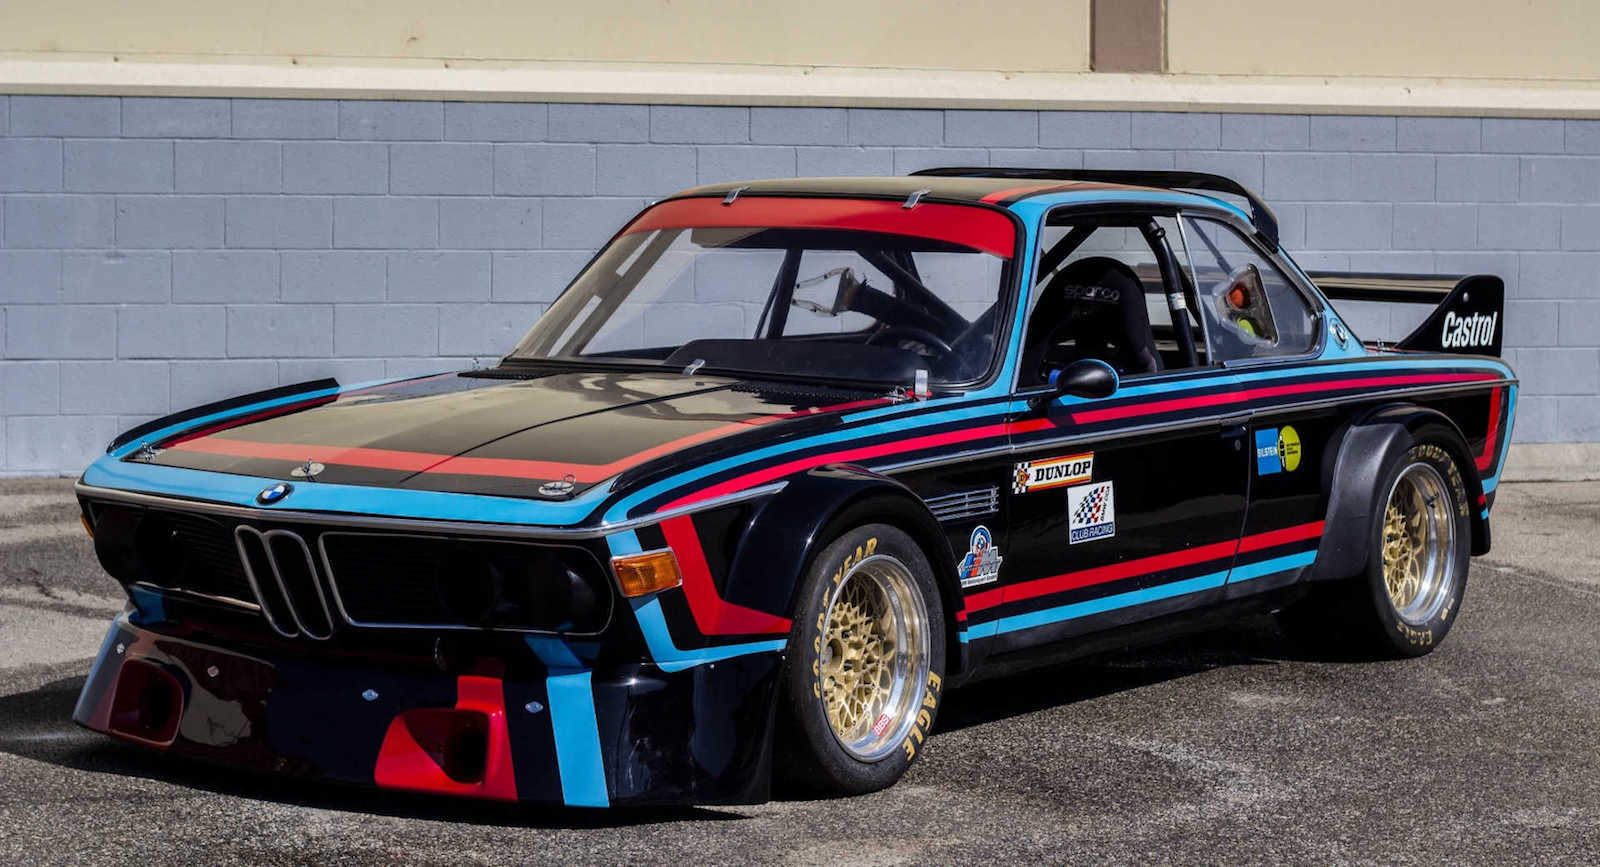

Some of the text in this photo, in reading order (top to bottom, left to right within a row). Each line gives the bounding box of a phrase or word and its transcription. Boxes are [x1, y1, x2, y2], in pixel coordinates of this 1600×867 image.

[1441, 311, 1498, 348] Castrol
[1034, 461, 1091, 482] DUNLOP
[1072, 523, 1113, 541] CLUB RACING
[873, 714, 889, 736] BBS
[902, 669, 942, 761] EAGLE
